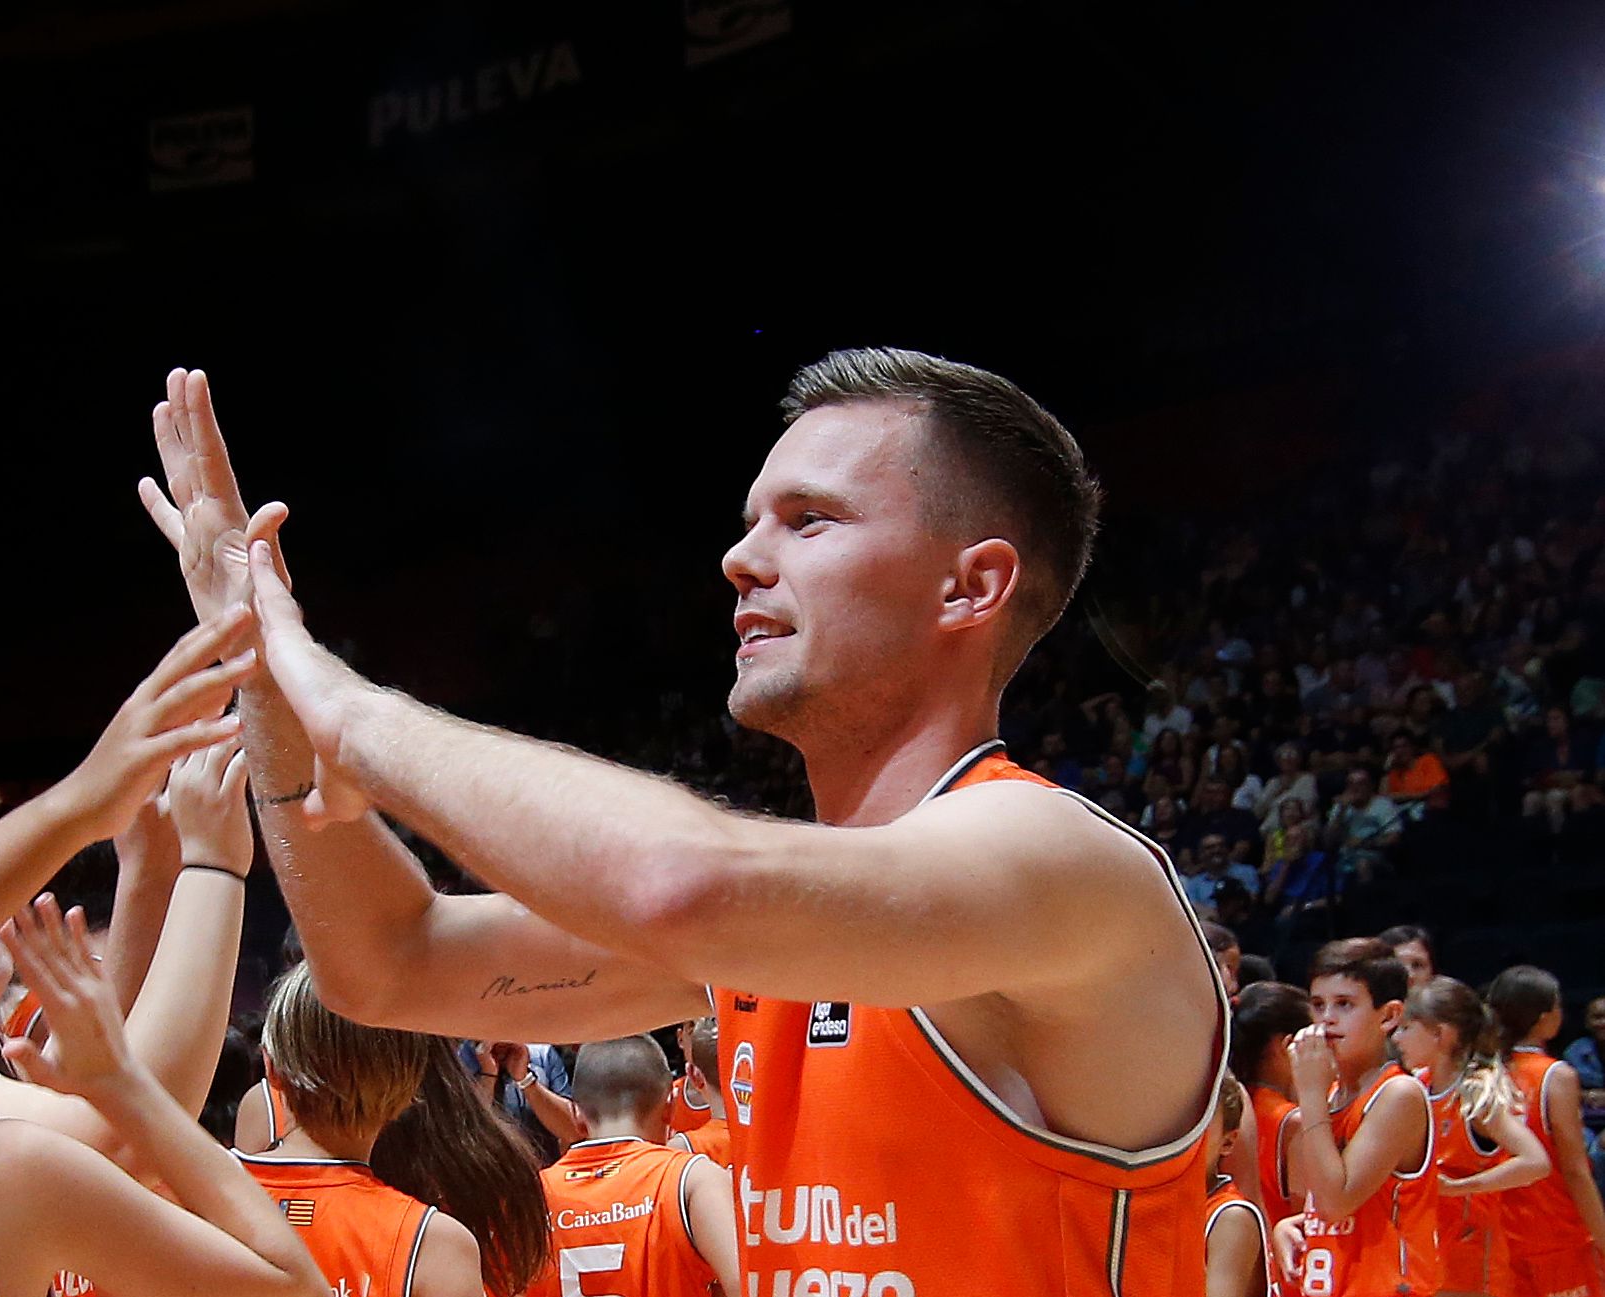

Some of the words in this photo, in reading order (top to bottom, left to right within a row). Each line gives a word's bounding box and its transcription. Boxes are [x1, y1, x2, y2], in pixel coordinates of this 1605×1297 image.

[366, 38, 583, 148] PULEVA
[812, 1017, 848, 1037] endesa
[557, 1196, 654, 1230] CaixaBank
[846, 1201, 897, 1247] del
